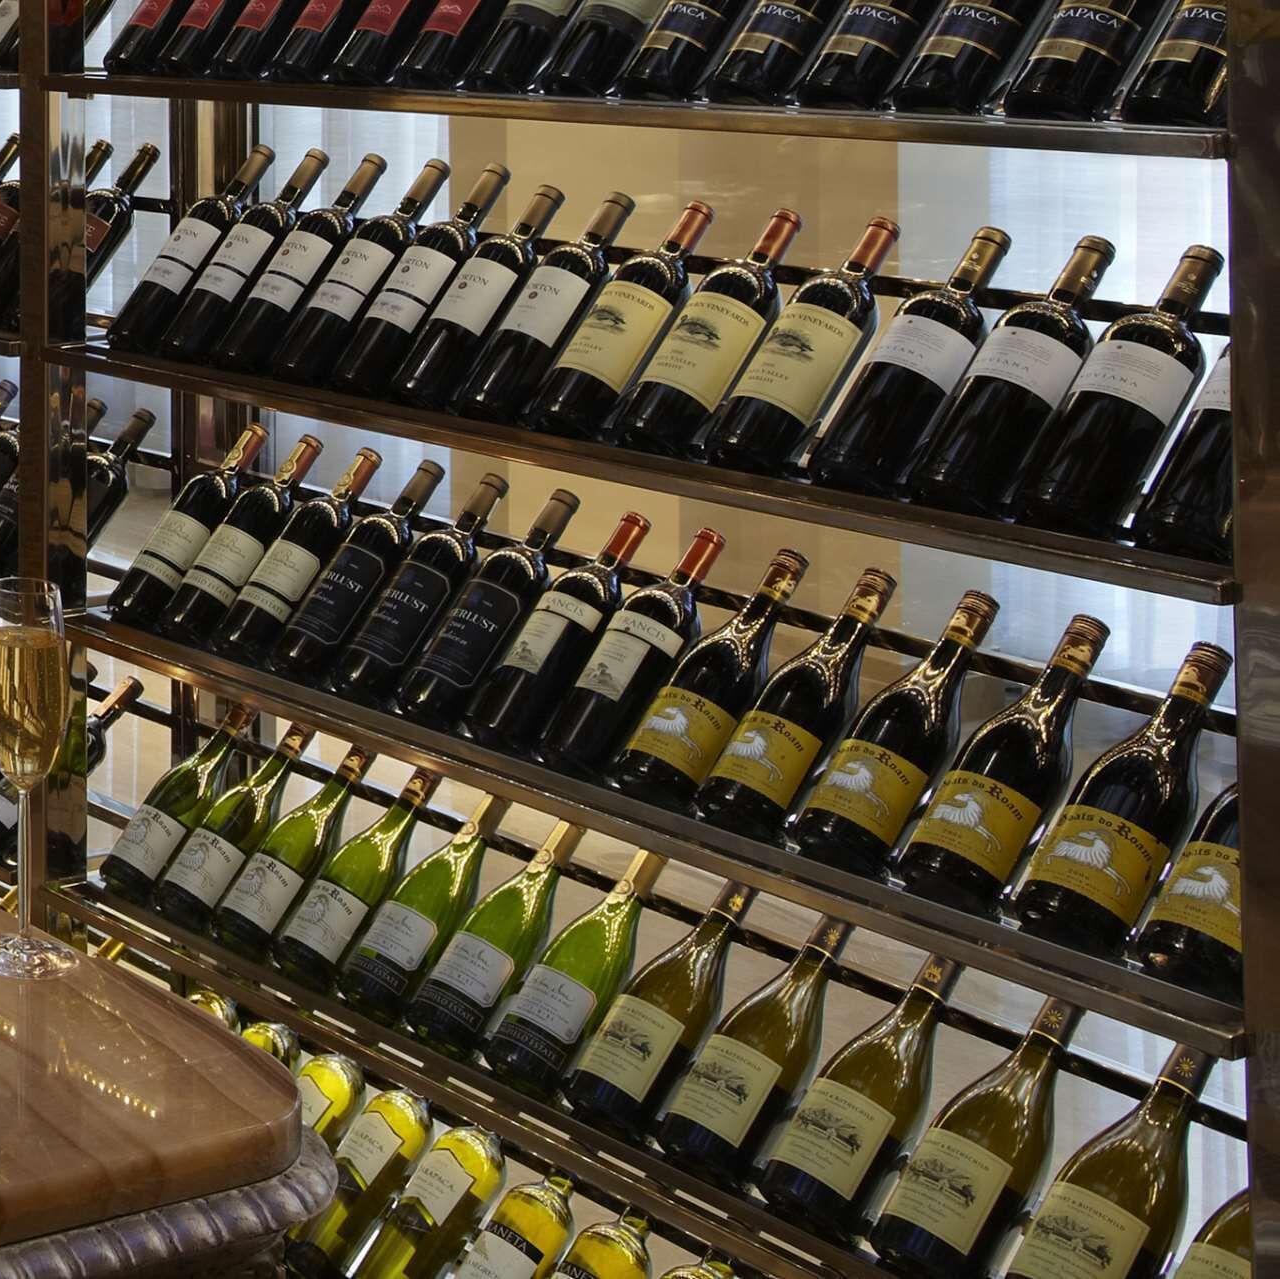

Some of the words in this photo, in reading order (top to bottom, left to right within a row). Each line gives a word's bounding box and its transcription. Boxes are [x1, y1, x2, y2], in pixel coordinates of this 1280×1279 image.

[874, 748, 911, 787] Roam
[985, 781, 1025, 822] Roam
[1113, 821, 1154, 863] Roam
